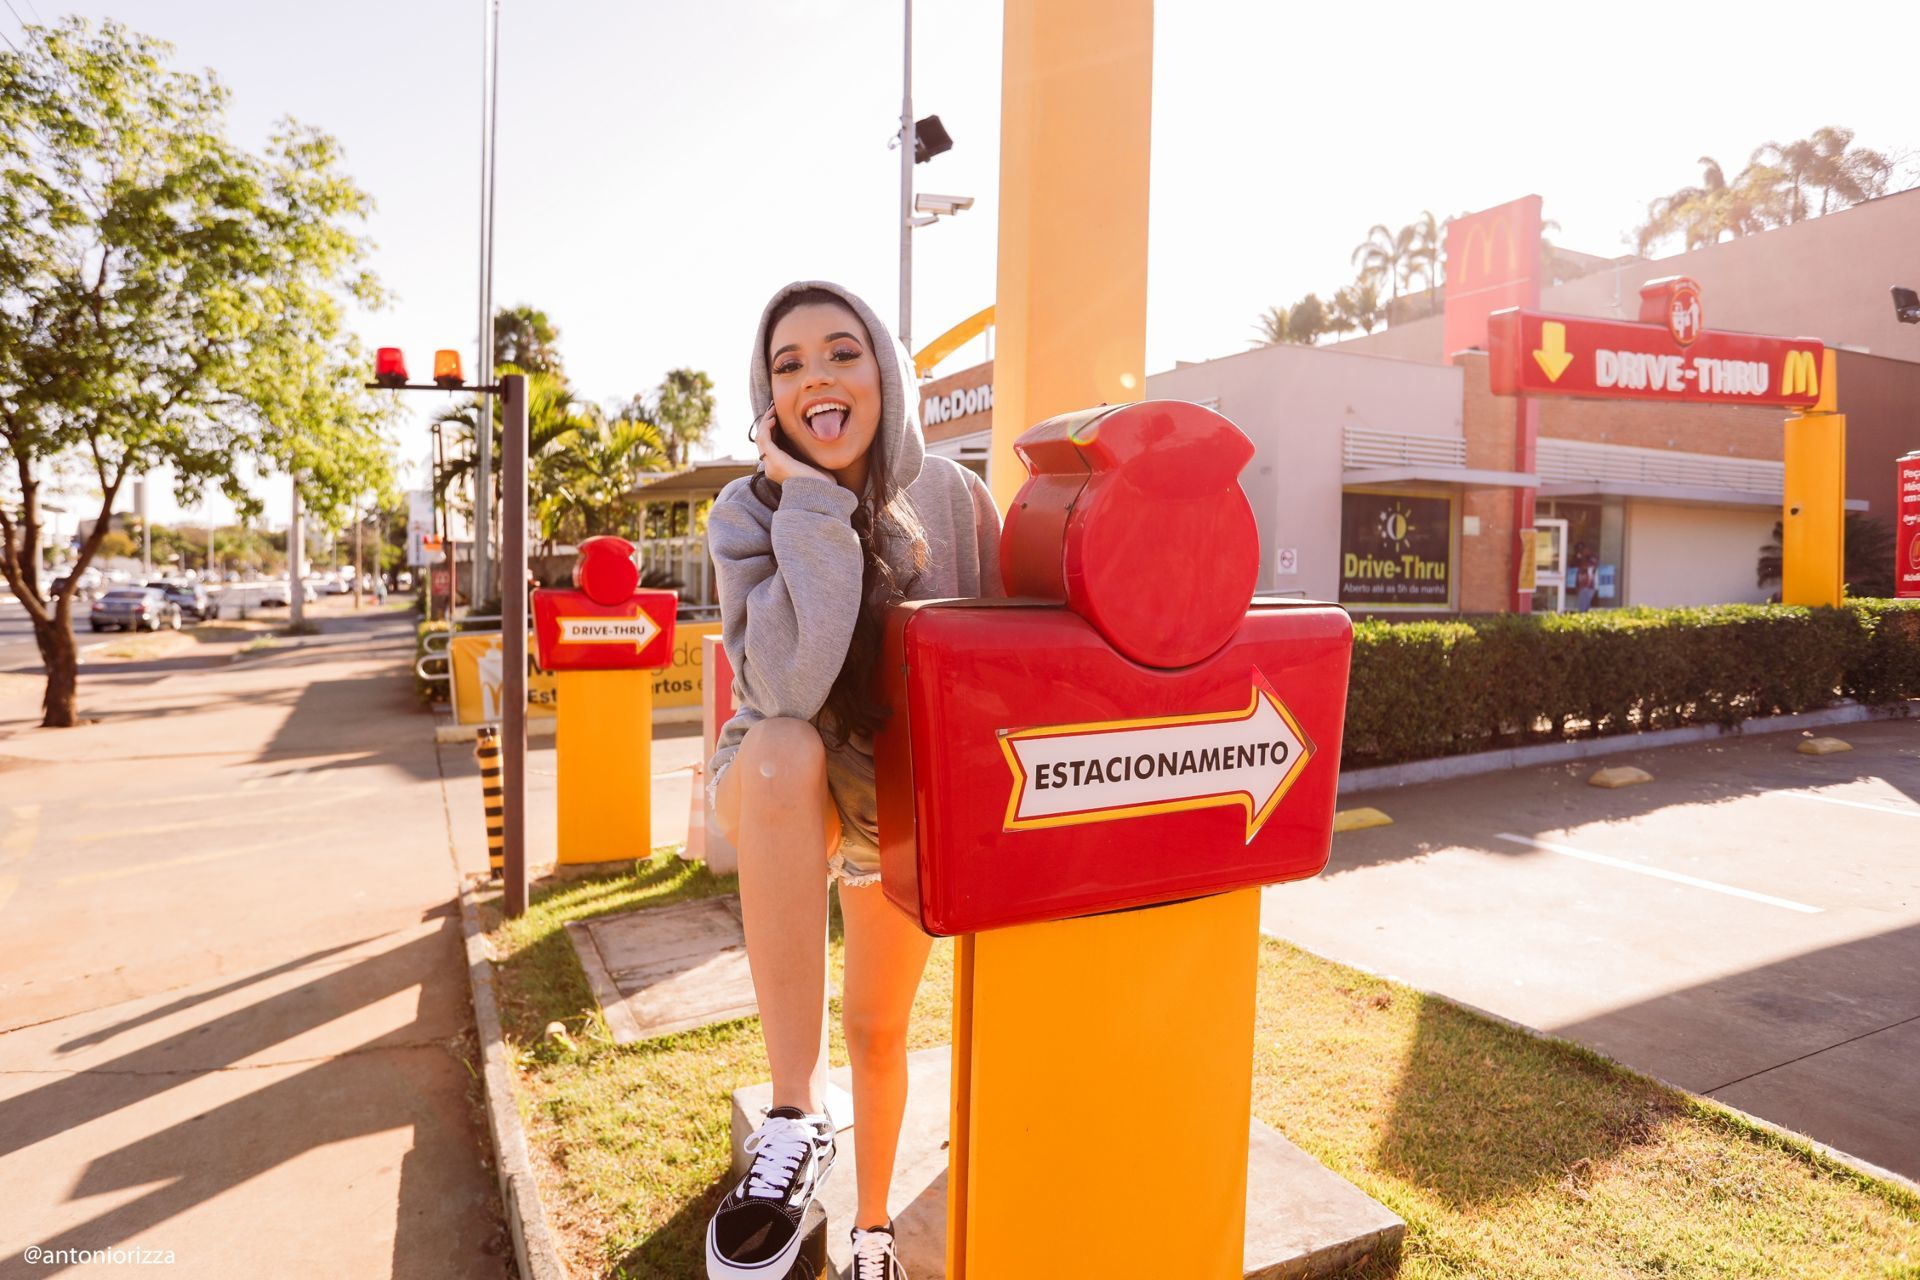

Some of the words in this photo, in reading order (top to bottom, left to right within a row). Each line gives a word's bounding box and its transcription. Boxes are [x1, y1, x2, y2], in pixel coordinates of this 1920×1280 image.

[1595, 349, 1769, 396] DRIVE-THRU
[1344, 553, 1445, 579] Drive-Thru
[1343, 583, 1370, 593] Aberto
[571, 626, 645, 635] DRIVE-THRU
[1034, 741, 1289, 790] ESTACIONAMENTO
